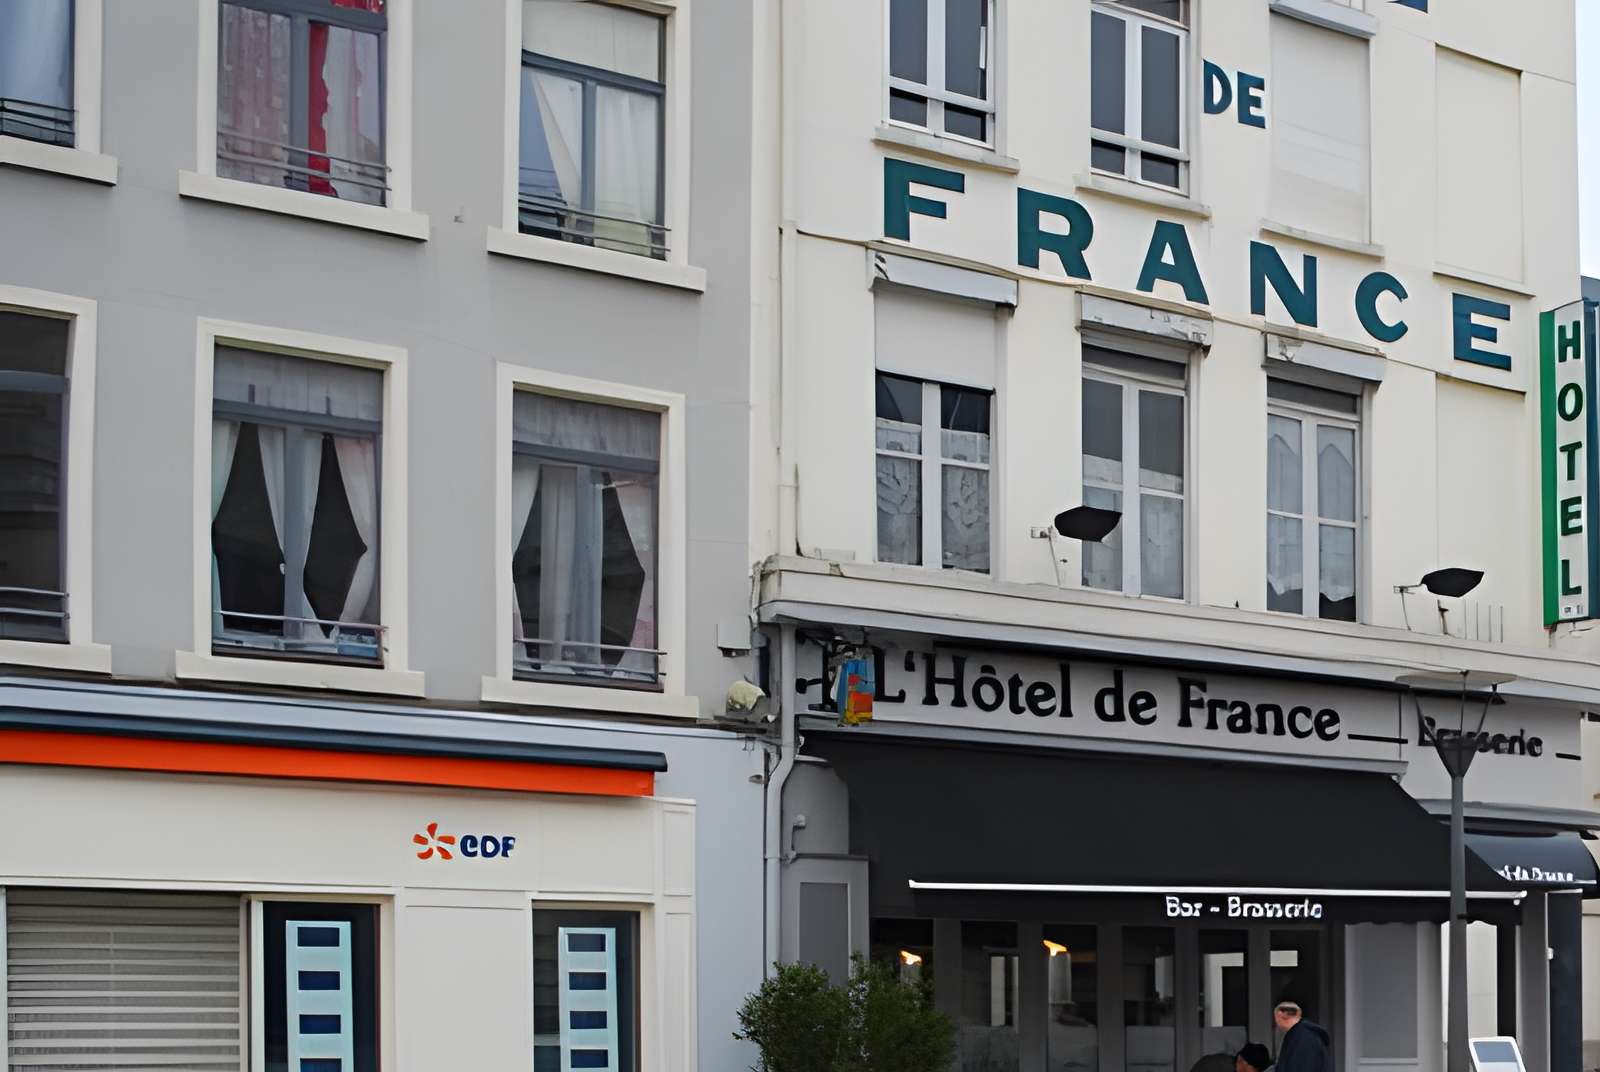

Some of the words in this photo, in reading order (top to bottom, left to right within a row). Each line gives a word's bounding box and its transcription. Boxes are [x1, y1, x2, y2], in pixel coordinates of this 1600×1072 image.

[1203, 58, 1266, 129] DE
[884, 158, 1512, 372] FRANCE
[1557, 319, 1584, 596] HOTEL
[1094, 669, 1157, 725] de
[1177, 676, 1340, 741] France
[1165, 895, 1203, 917] Bar
